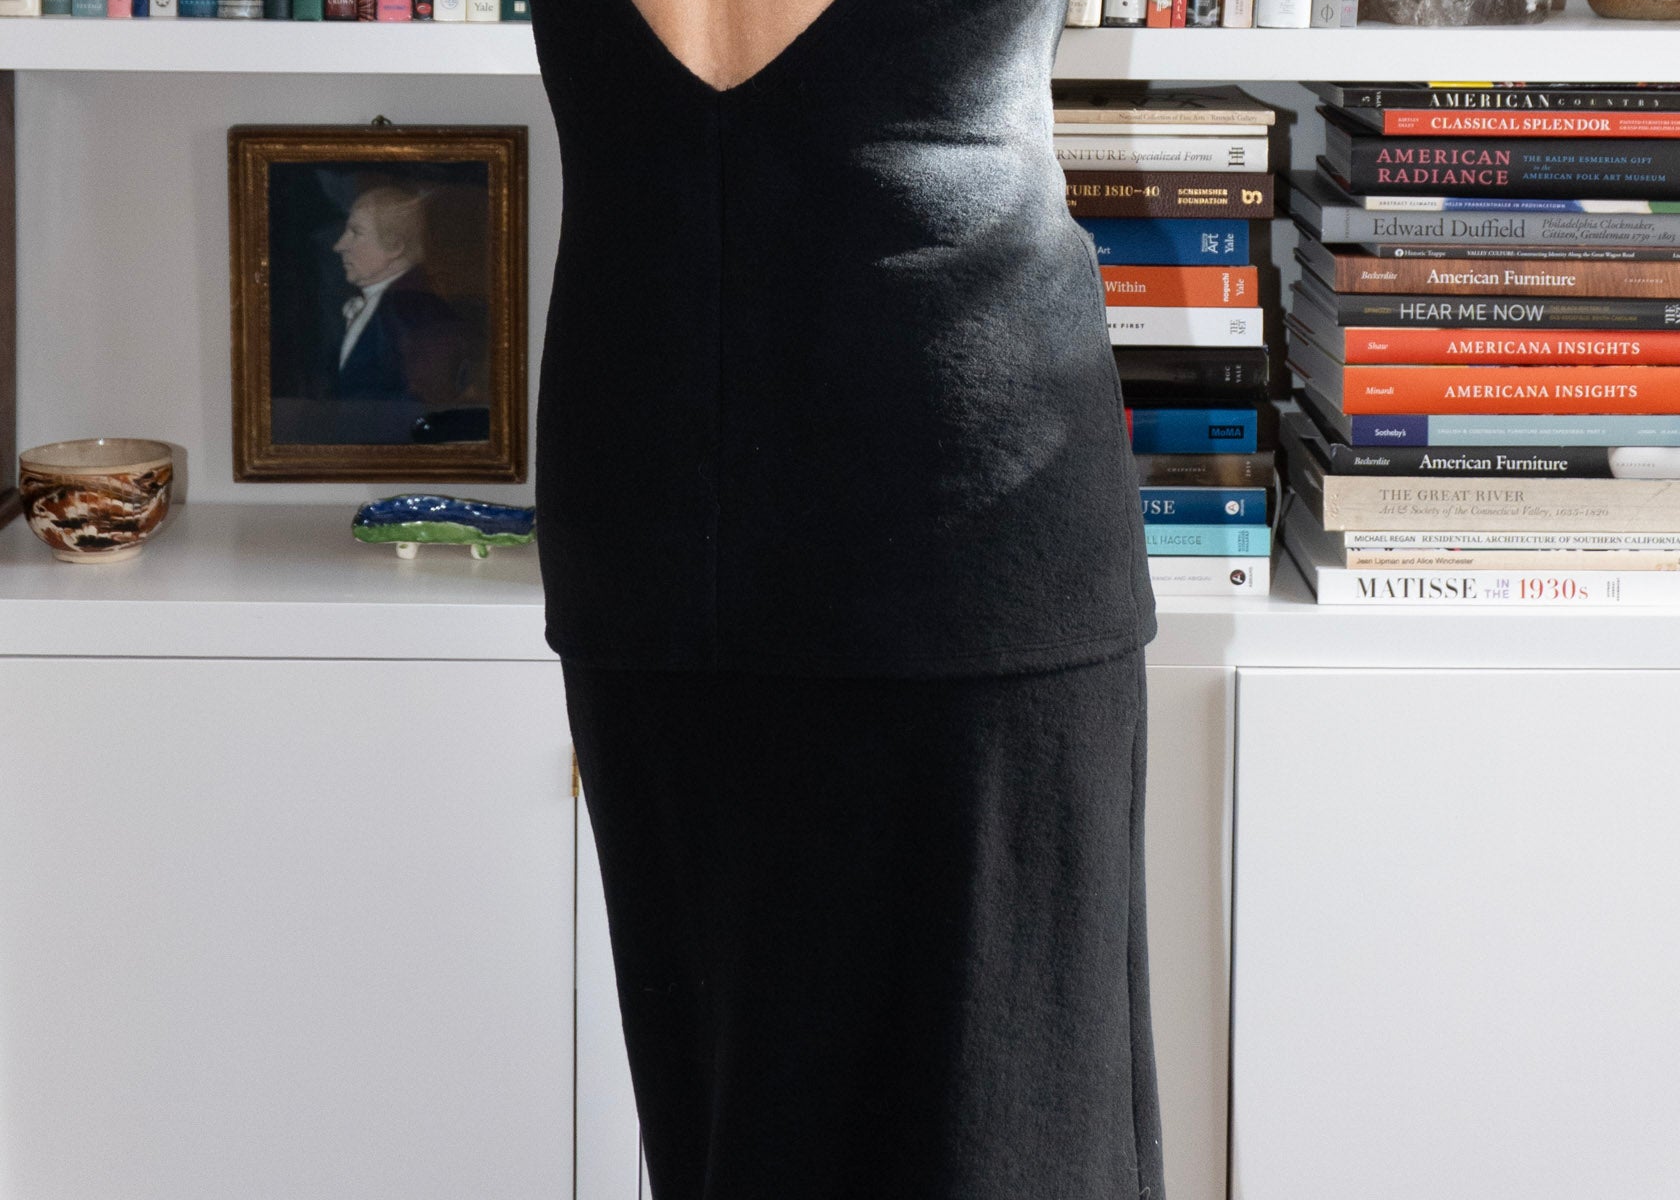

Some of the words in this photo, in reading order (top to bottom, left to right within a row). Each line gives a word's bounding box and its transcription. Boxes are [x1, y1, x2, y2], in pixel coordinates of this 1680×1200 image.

[475, 2, 495, 11] Yale
[1429, 92, 1551, 109] AMERICAN
[1557, 98, 1662, 109] COUNTRY
[1430, 116, 1520, 132] CLASSICAL
[1522, 118, 1612, 133] SPLENDOR
[1131, 150, 1182, 163] Specialized
[1183, 150, 1213, 161] Forms
[1376, 148, 1512, 167] AMERICAN
[1523, 155, 1542, 165] THE
[1544, 155, 1576, 165] RALPH
[1579, 155, 1628, 166] ESMERIAN
[1630, 156, 1653, 166] GIFT
[1378, 168, 1510, 186] RADIANCE
[1522, 172, 1573, 181] AMERICAN
[1575, 173, 1601, 182] FOLK
[1603, 173, 1622, 182] ART
[1625, 174, 1667, 183] MUSEUM
[1177, 197, 1228, 205] FOUNDATION
[1373, 217, 1445, 238] Edward
[1451, 217, 1526, 240] Duffield
[1541, 219, 1598, 233] Philadelphia
[1600, 220, 1656, 234] Clockmaker,
[1541, 229, 1578, 242] Citizen,
[1580, 229, 1628, 241] Gentleman
[1097, 246, 1111, 255] Art
[1225, 233, 1235, 254] Yale
[1427, 268, 1499, 286] American
[1504, 269, 1577, 287] Furniture
[1105, 280, 1147, 294] Within
[1236, 278, 1245, 297] Yale
[1400, 303, 1453, 321] HEAR
[1459, 304, 1488, 322] ME
[1493, 304, 1545, 322] NOW
[1367, 343, 1389, 351] Shaw
[1446, 341, 1552, 356] AMERICANA
[1557, 341, 1641, 356] INSIGHTS
[1365, 386, 1395, 396] Minardi
[1444, 384, 1550, 399] AMERICANA
[1555, 385, 1639, 400] INSIGHTS
[1374, 428, 1407, 440] Sotheby's
[1419, 453, 1492, 471] American
[1496, 455, 1569, 472] Furniture
[1379, 488, 1413, 502] THE
[1417, 489, 1471, 503] GREAT
[1475, 490, 1526, 503] RIVER
[1378, 505, 1394, 516] Art
[1408, 505, 1444, 519] Society
[1456, 506, 1469, 517] the
[1470, 506, 1521, 518] Connecticut
[1160, 535, 1203, 546] HAGEGE
[1354, 535, 1388, 543] MICHAEL
[1389, 535, 1416, 543] REGAN
[1421, 535, 1483, 544] RESIDENTIAL
[1484, 536, 1557, 545] ARCHITECTURE
[1558, 536, 1571, 545] OF
[1572, 536, 1623, 545] SOUTHERN
[1356, 557, 1374, 566] Jean
[1374, 557, 1401, 568] Lipman
[1401, 557, 1414, 566] and
[1415, 557, 1434, 566] Alice
[1435, 557, 1474, 566] Winchester
[1356, 577, 1477, 600] MATISSE
[1495, 579, 1510, 590] IN
[1518, 577, 1590, 600] 1930s
[1483, 589, 1511, 600] THE
